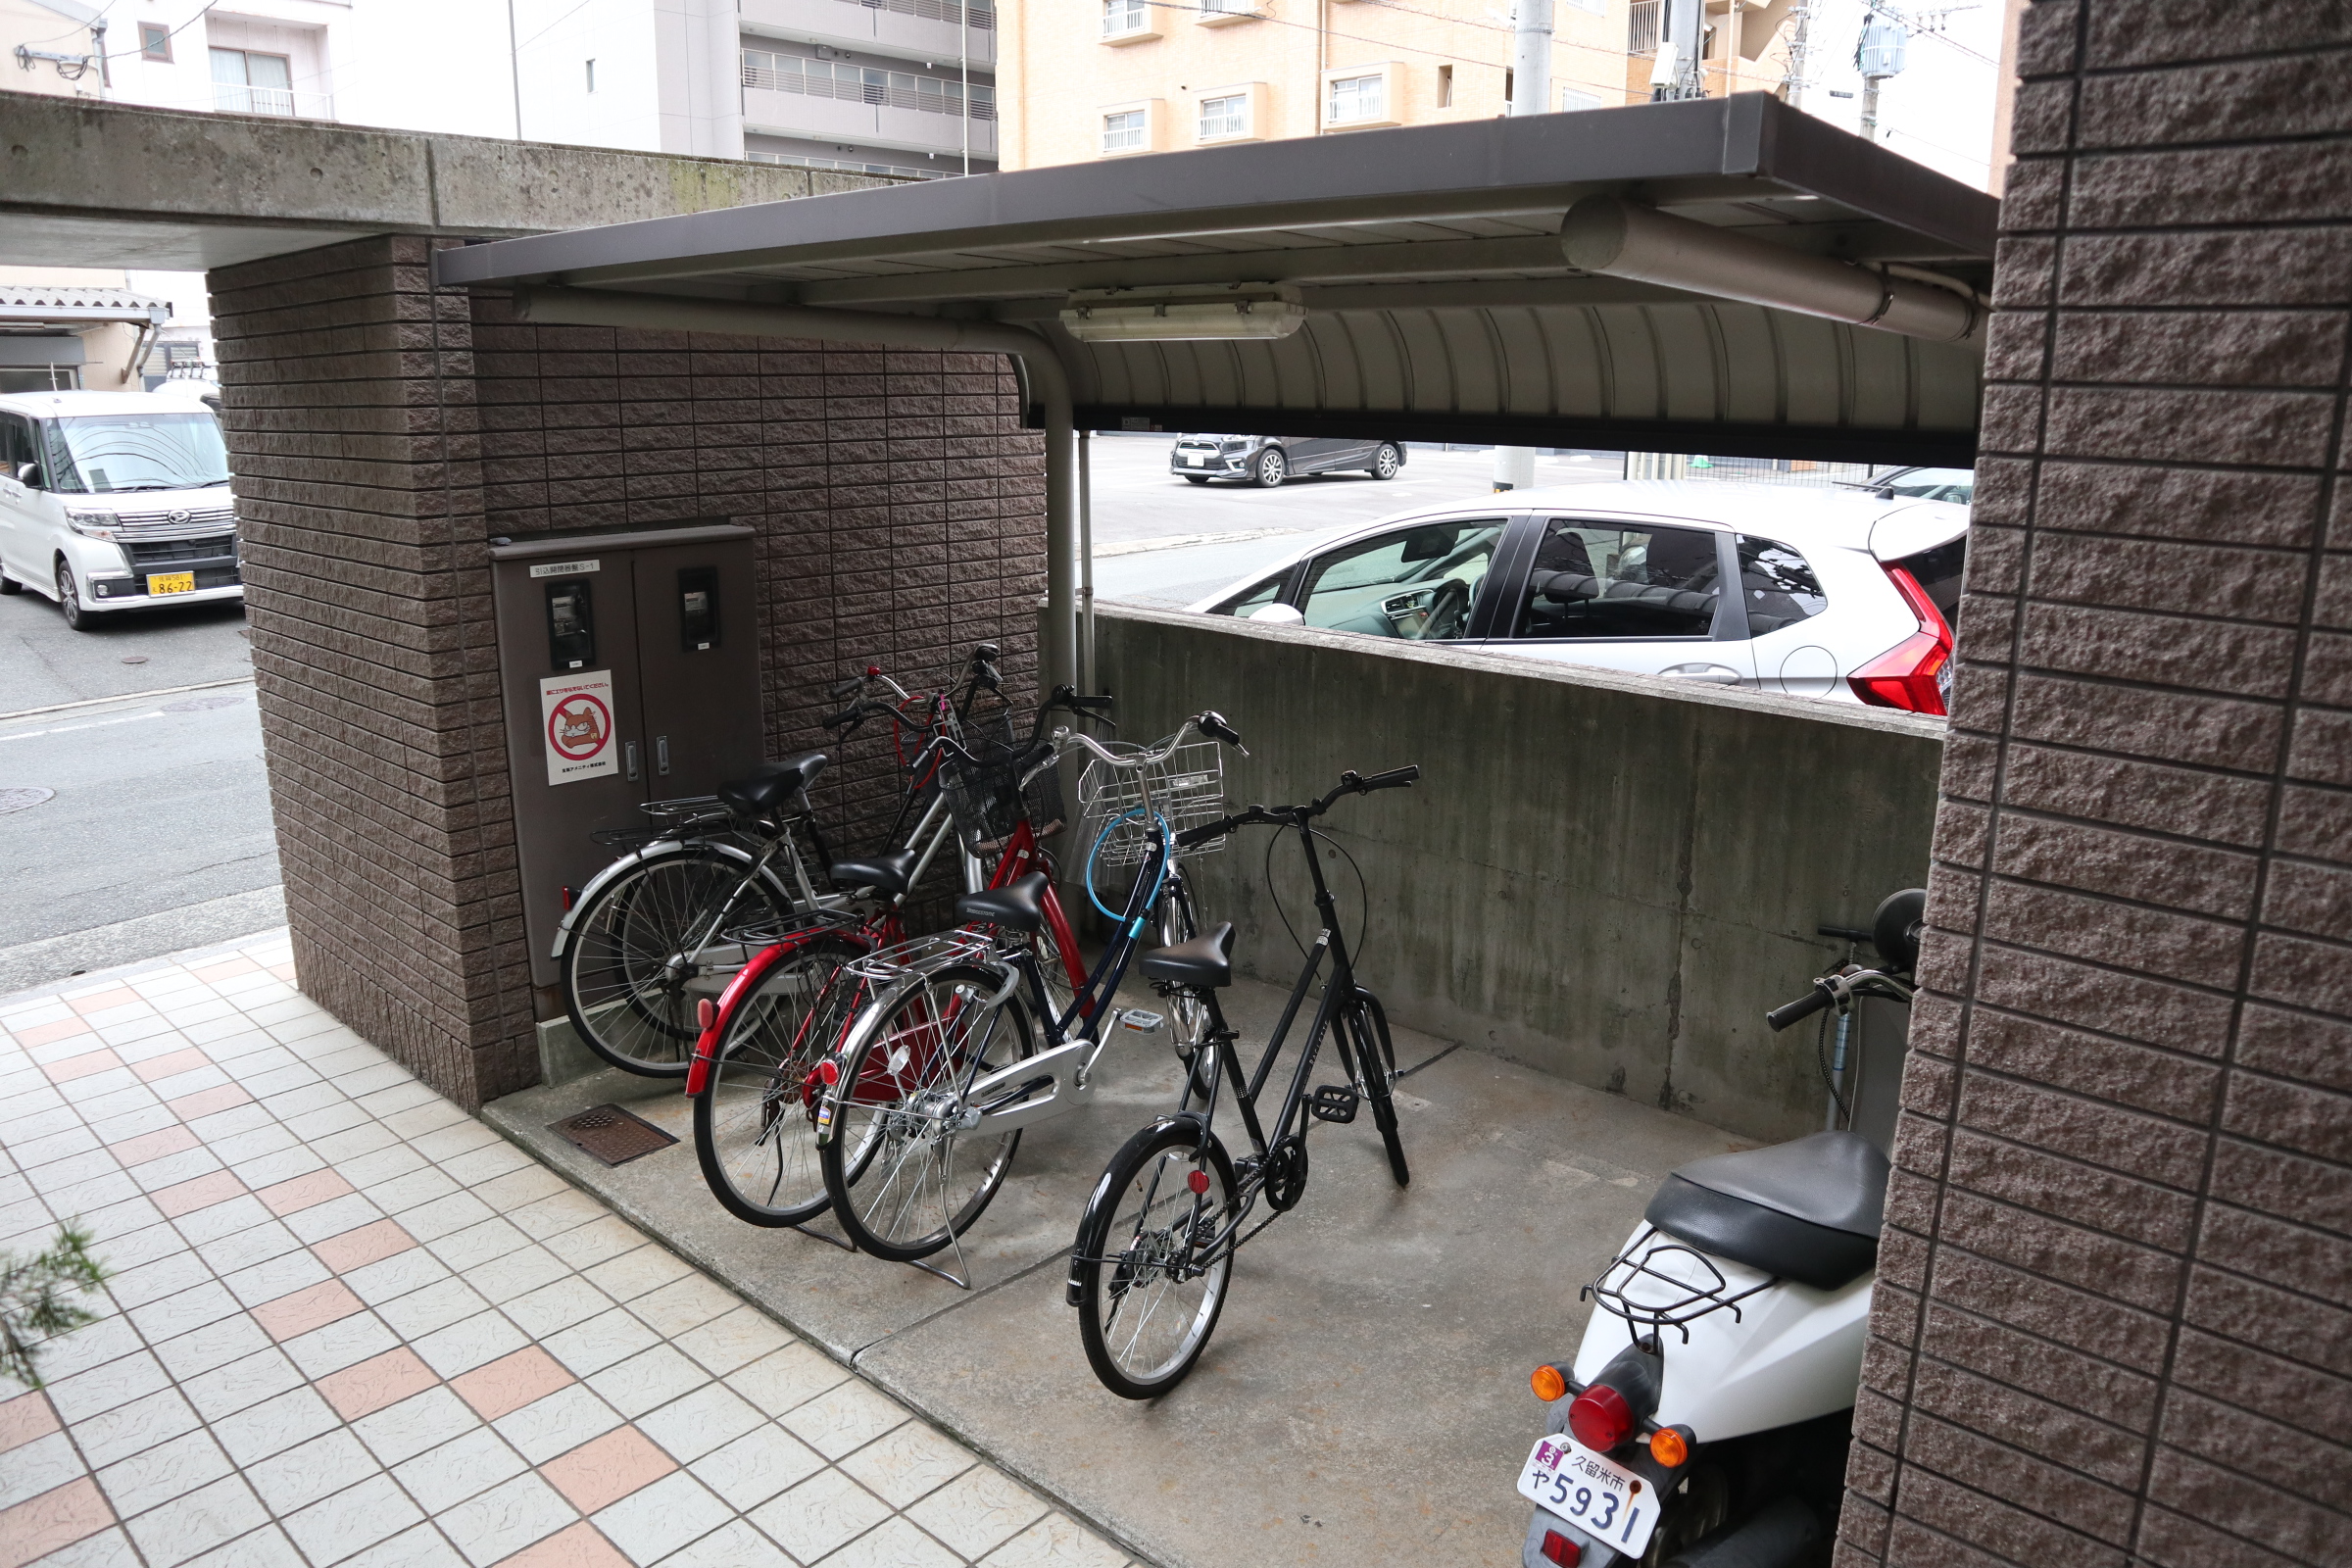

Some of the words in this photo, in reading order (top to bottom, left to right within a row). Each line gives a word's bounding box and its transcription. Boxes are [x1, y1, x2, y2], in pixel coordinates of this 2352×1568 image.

[159, 580, 192, 594] 86-22
[1541, 1451, 1555, 1467] 3
[1571, 1455, 1626, 1492] 久留米市
[1532, 1470, 1550, 1490] や
[1549, 1473, 1641, 1544] 5931
